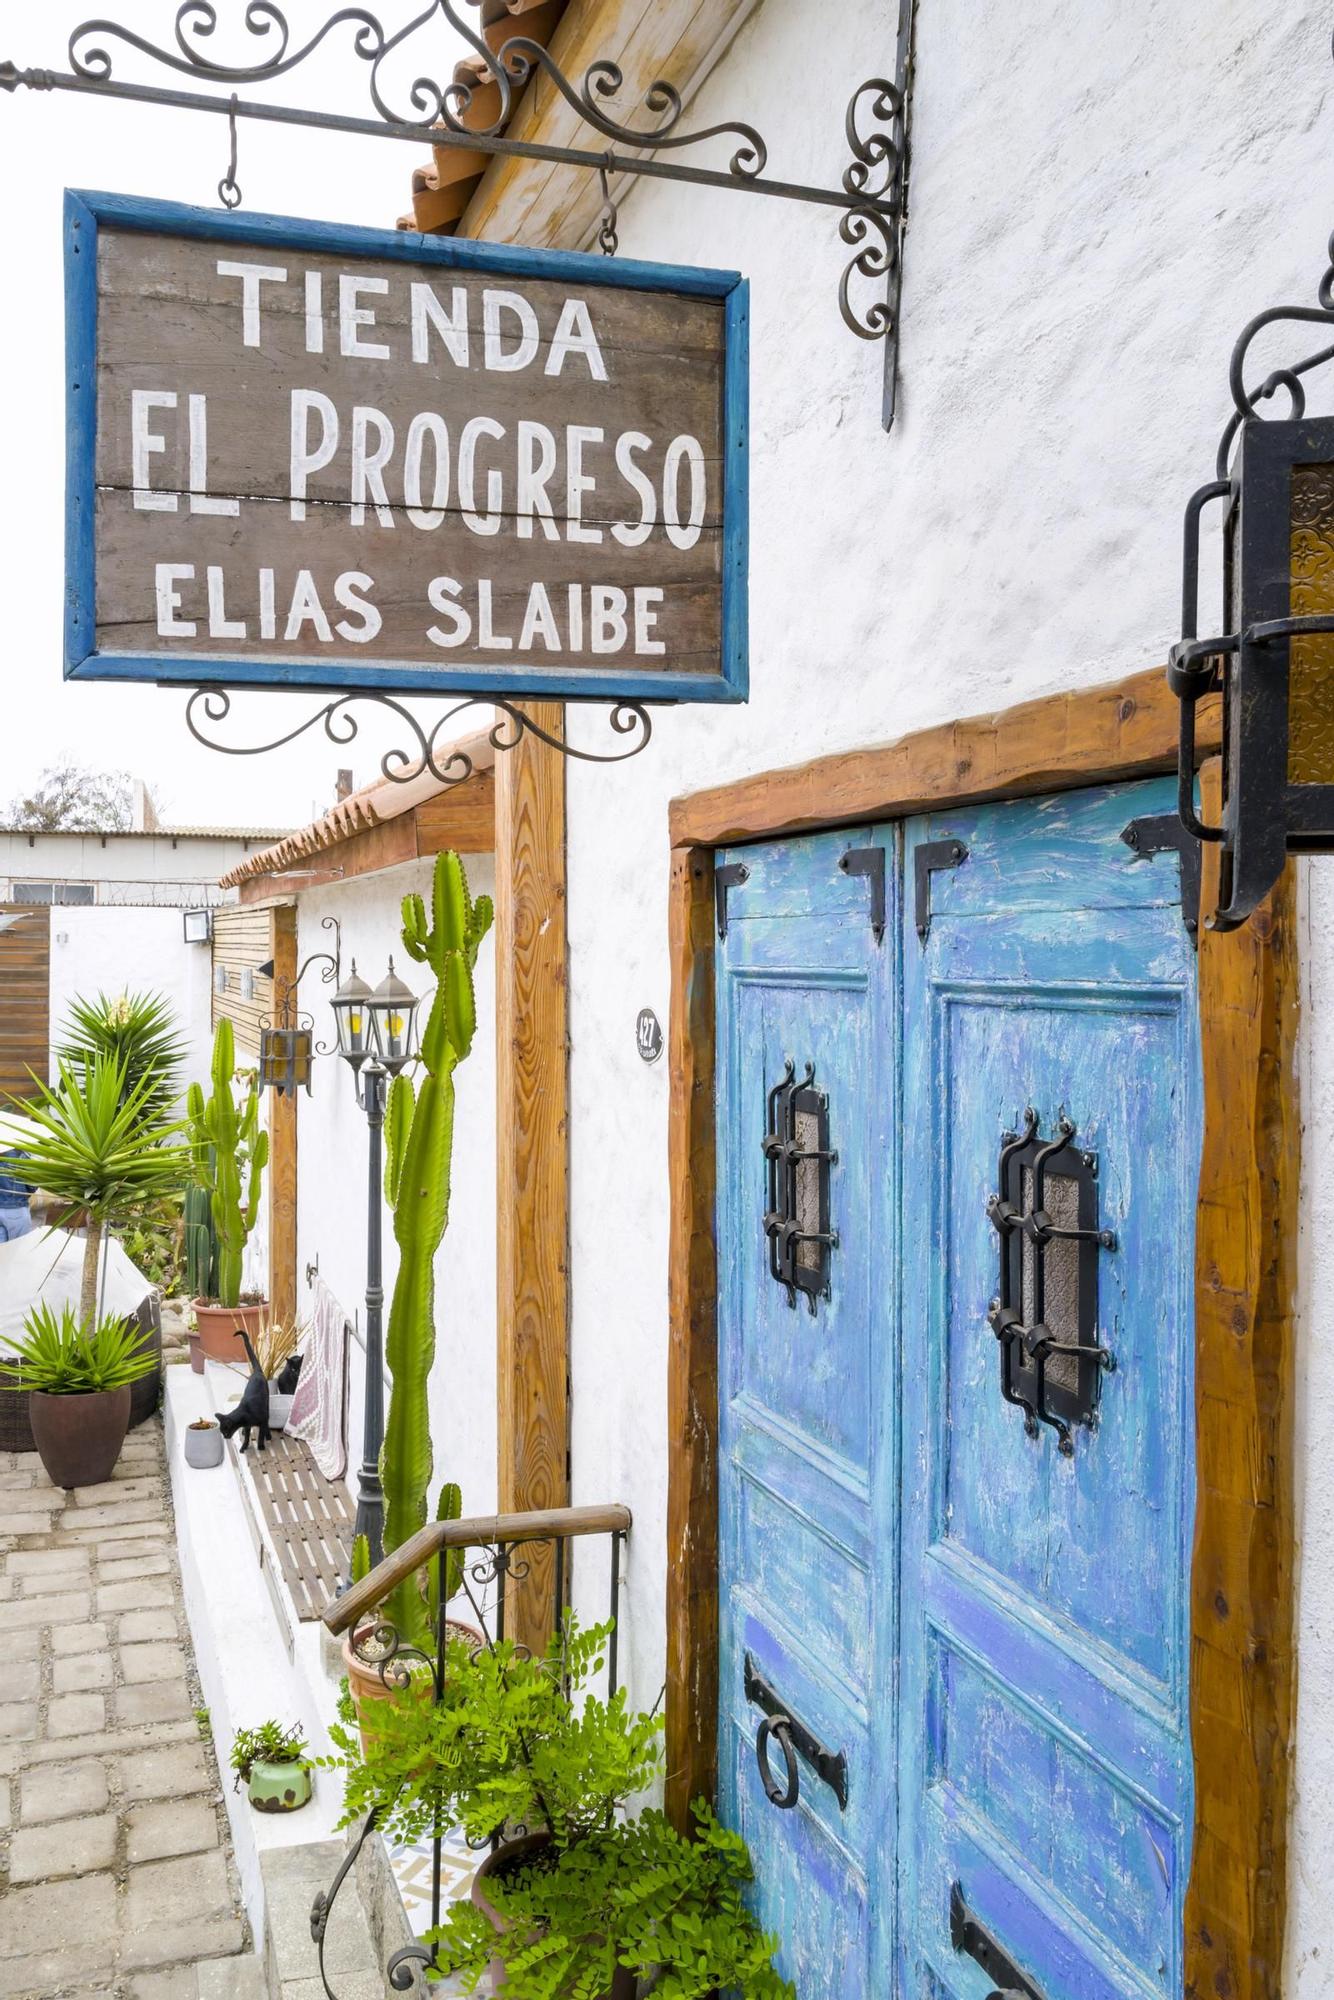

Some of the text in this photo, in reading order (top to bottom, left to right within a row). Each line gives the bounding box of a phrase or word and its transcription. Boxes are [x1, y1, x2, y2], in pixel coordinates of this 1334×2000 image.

[216, 259, 608, 381] TIENDA
[131, 388, 706, 550] EL PROGRESO
[155, 563, 666, 655] ELIAS SLAIBE
[639, 1016, 655, 1047] 427
